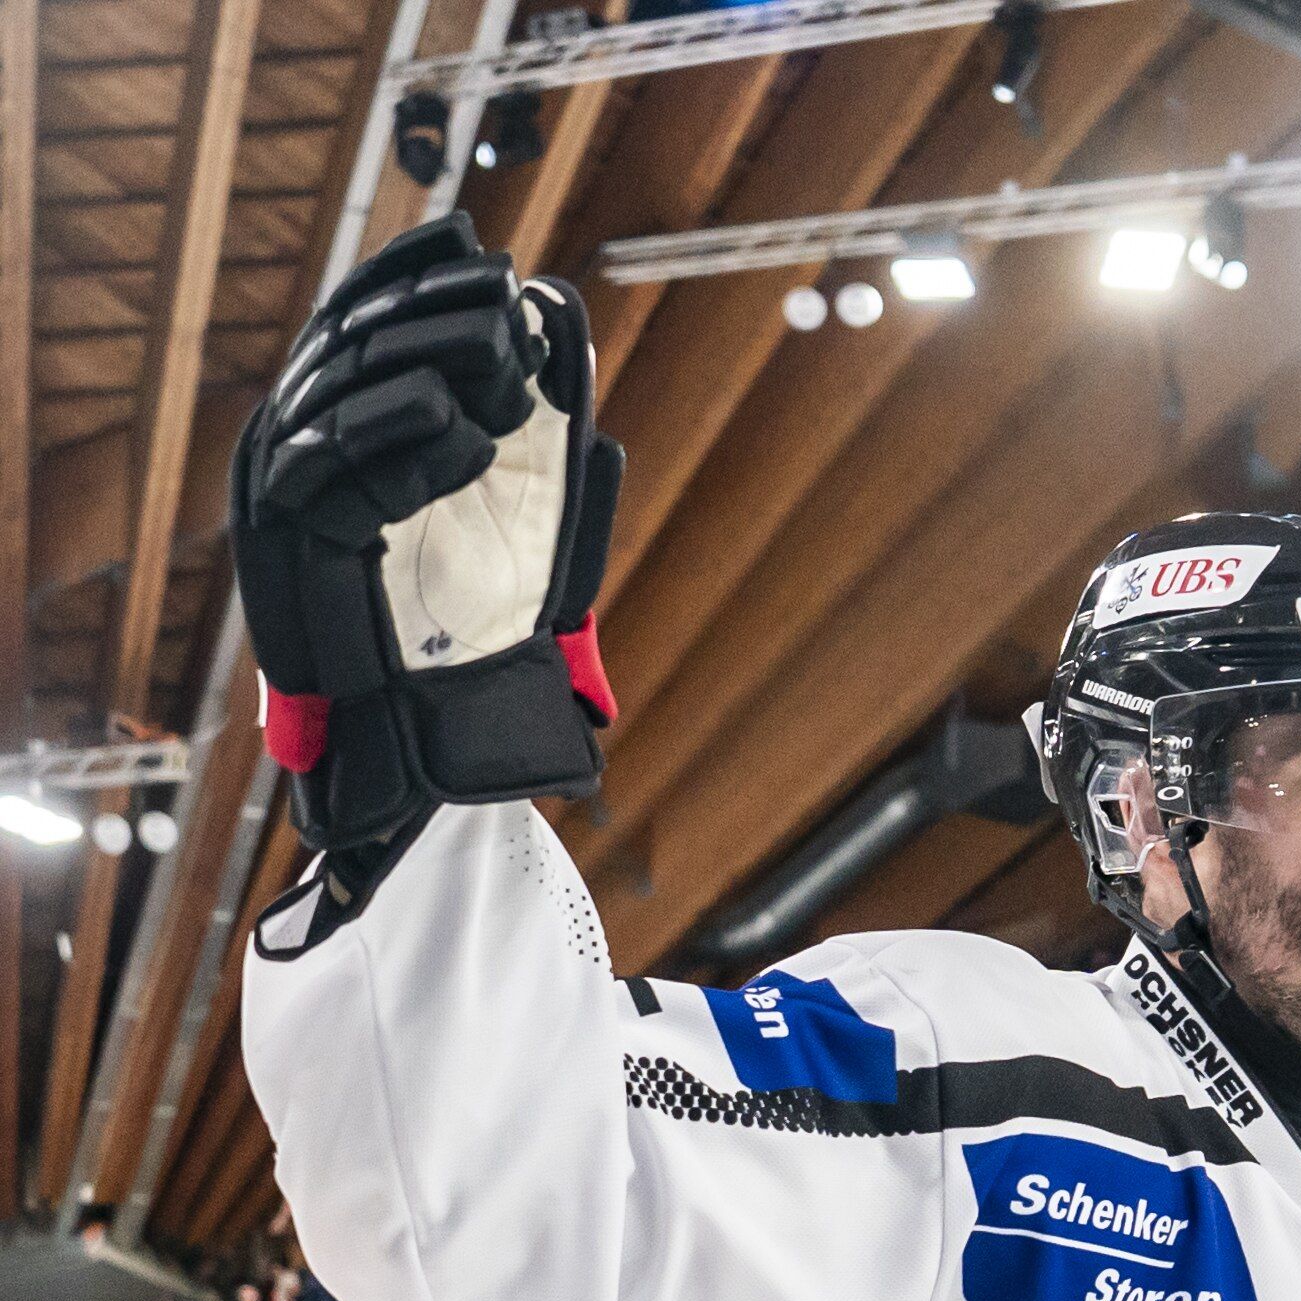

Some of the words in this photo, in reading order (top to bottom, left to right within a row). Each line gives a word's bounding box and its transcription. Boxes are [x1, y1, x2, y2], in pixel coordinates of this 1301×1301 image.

[1151, 558, 1242, 597] UBS
[1081, 679, 1155, 716] WARRIOR
[1124, 953, 1264, 1128] OCHSNER
[1010, 1174, 1188, 1246] Schenker
